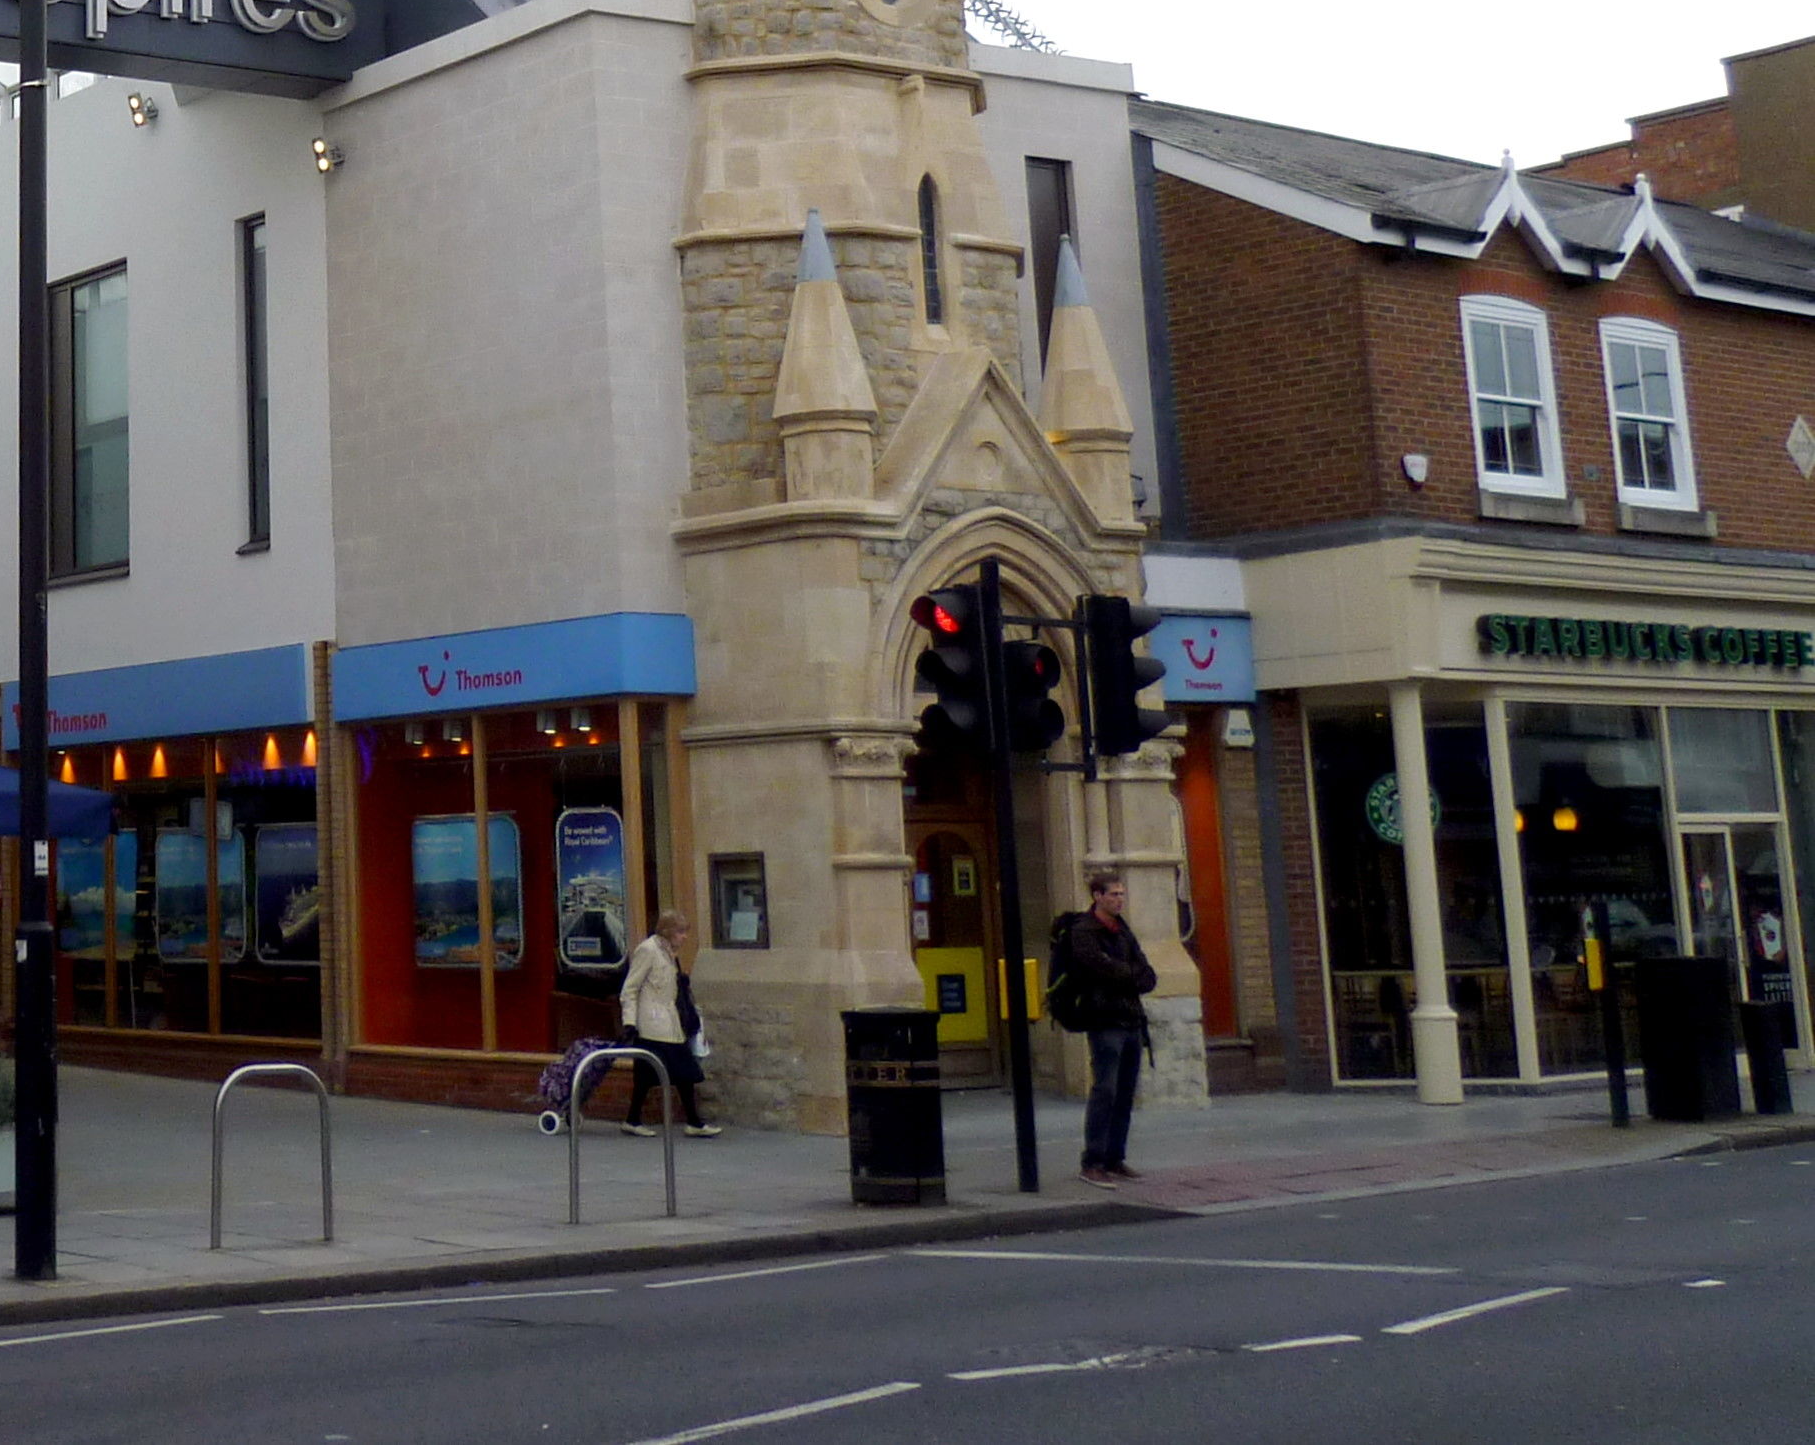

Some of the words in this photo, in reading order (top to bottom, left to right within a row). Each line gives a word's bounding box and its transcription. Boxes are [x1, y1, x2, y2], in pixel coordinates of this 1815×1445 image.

[1485, 613, 1694, 662] STARBUCKS
[1699, 625, 1815, 668] COFFEE
[455, 669, 523, 691] Thomson
[1185, 679, 1223, 691] Thomson
